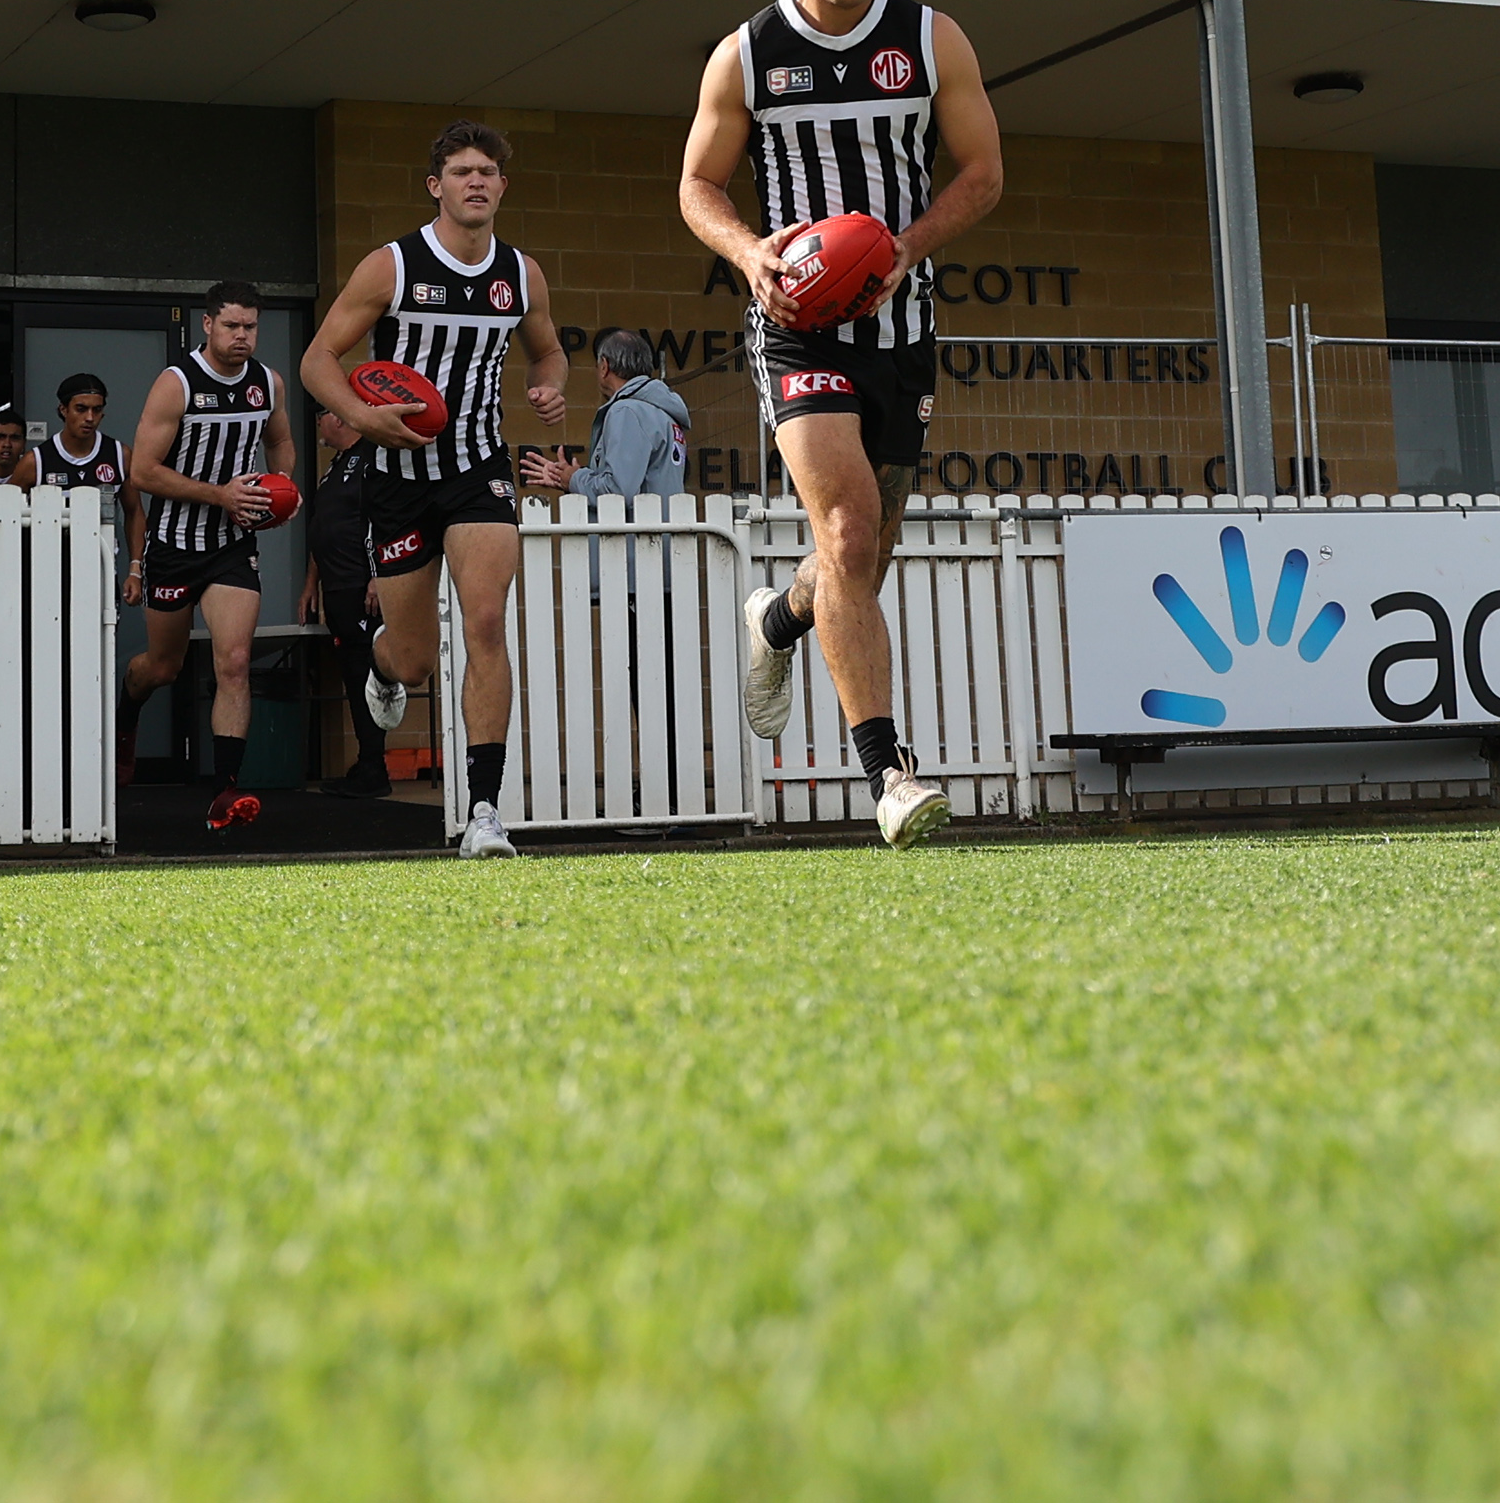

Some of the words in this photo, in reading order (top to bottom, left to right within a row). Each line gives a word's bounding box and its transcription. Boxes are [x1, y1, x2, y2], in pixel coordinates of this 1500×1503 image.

[872, 51, 911, 89] MG
[490, 282, 512, 309] MG
[934, 264, 1080, 305] COTT
[941, 343, 1210, 386] QUARTERS
[787, 372, 849, 397] KFC
[912, 450, 1184, 495] FOOTBALL
[1204, 455, 1331, 496] CUB
[382, 533, 419, 561] KFC
[154, 587, 185, 600] KFC
